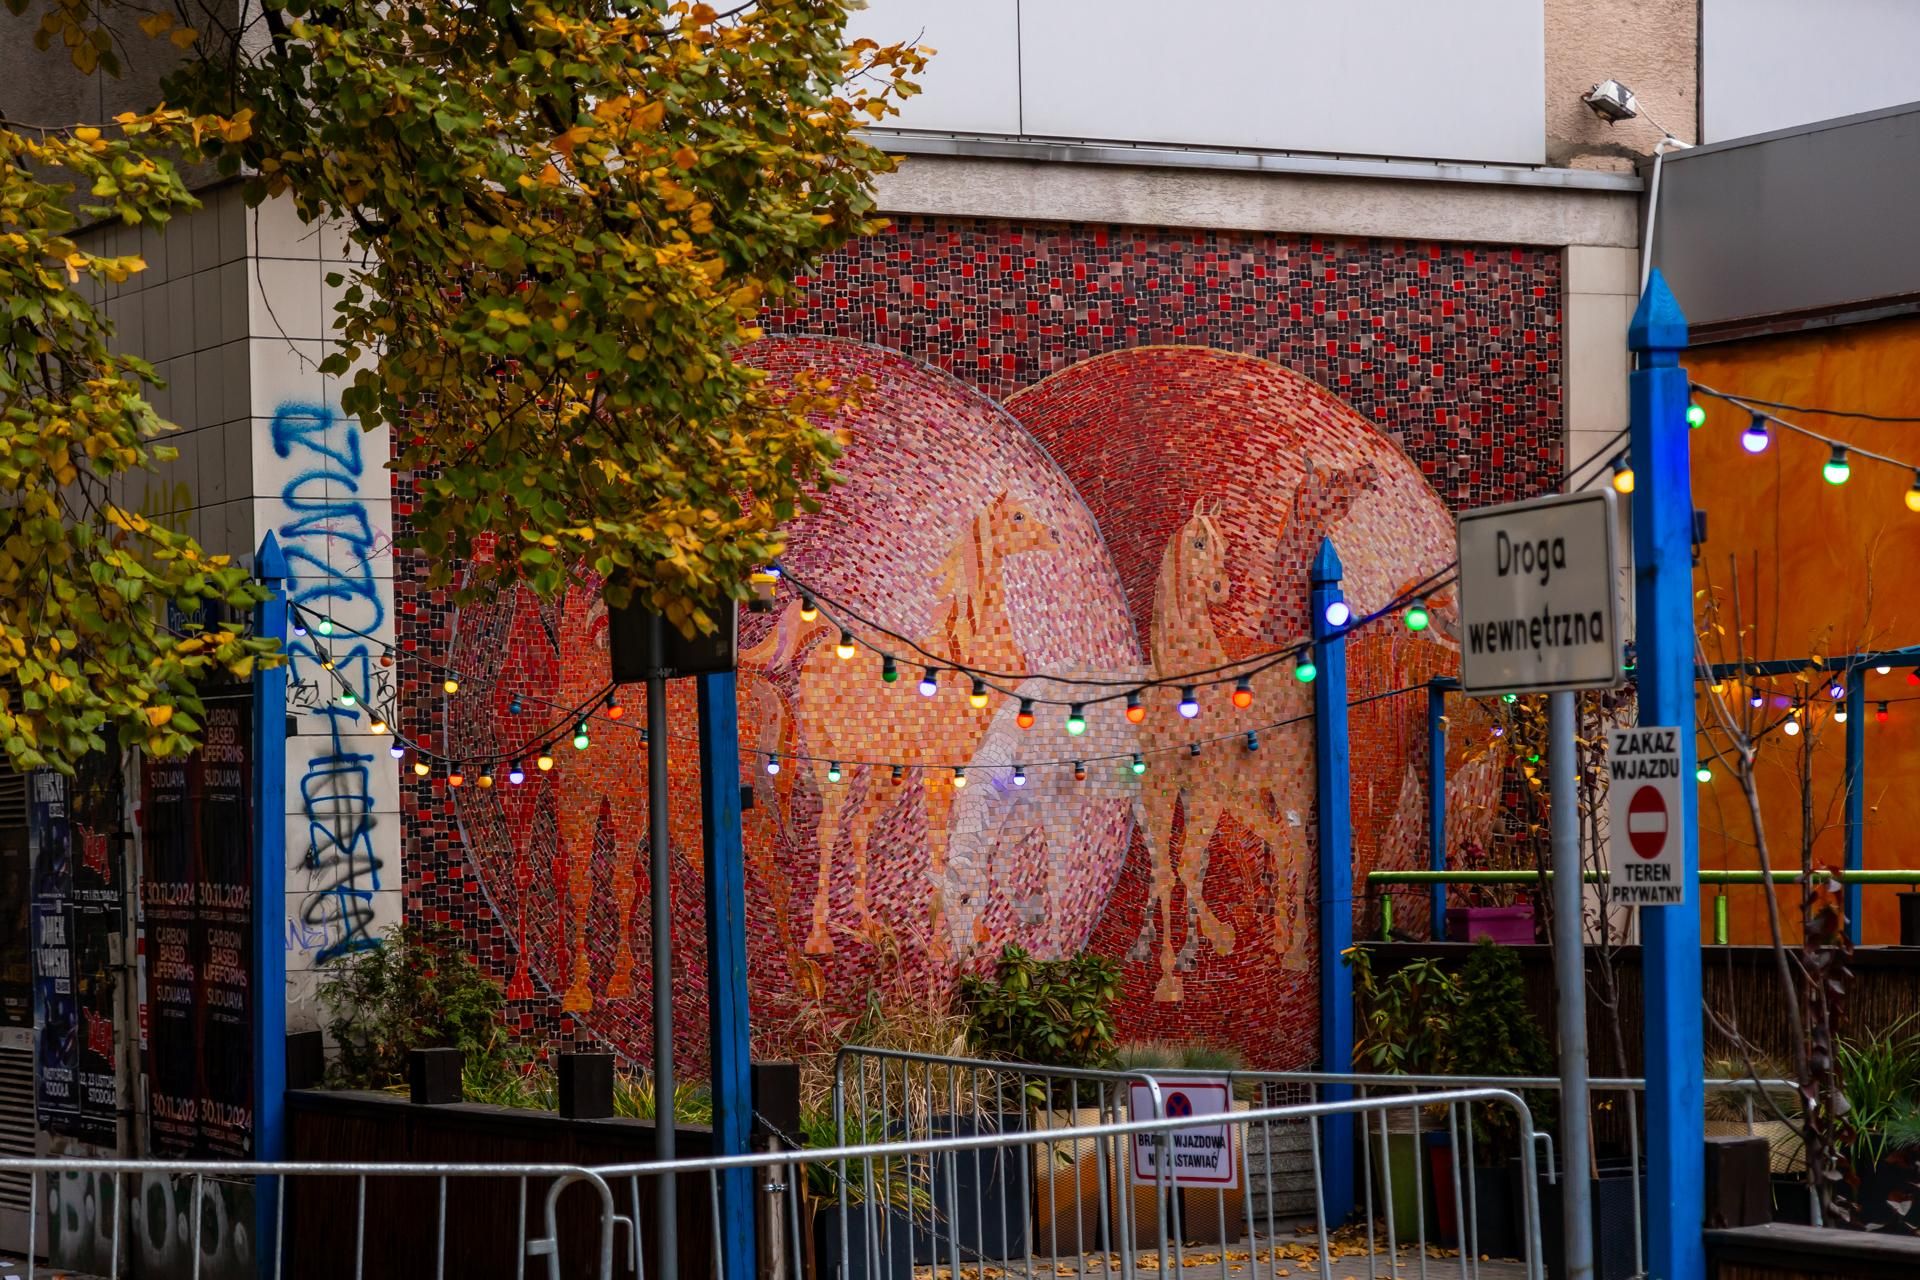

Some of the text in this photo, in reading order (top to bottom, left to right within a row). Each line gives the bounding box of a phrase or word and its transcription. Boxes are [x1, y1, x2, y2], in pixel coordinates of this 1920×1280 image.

[1497, 529, 1566, 586] Droga
[1469, 602, 1605, 661] wewnętrzna
[206, 708, 239, 727] CARBON
[208, 727, 235, 746] BASED
[1615, 732, 1676, 756] ZAKAZ
[201, 744, 244, 764] LIFEFORMS
[151, 769, 185, 788] SUDUAYA
[204, 769, 241, 788] SUDUAYA
[1611, 757, 1680, 781] WJAZDU
[1625, 864, 1671, 882] TEREN
[147, 882, 195, 906] 30.11.2024
[199, 882, 251, 909] 30.11.2024
[1613, 885, 1682, 903] PRYWATNY
[155, 927, 189, 947] CARBON
[208, 928, 242, 949] CARBON
[160, 945, 185, 963] BASED
[211, 948, 239, 968] BASED
[152, 961, 194, 982] LIFEFORMS
[203, 963, 247, 987] LIFEFORMS
[156, 985, 191, 1006] SUDUAYA
[207, 987, 243, 1010] SUDUAYA
[201, 1097, 252, 1130] 30.11.2024
[1174, 1135, 1226, 1149] WJAZDOWA
